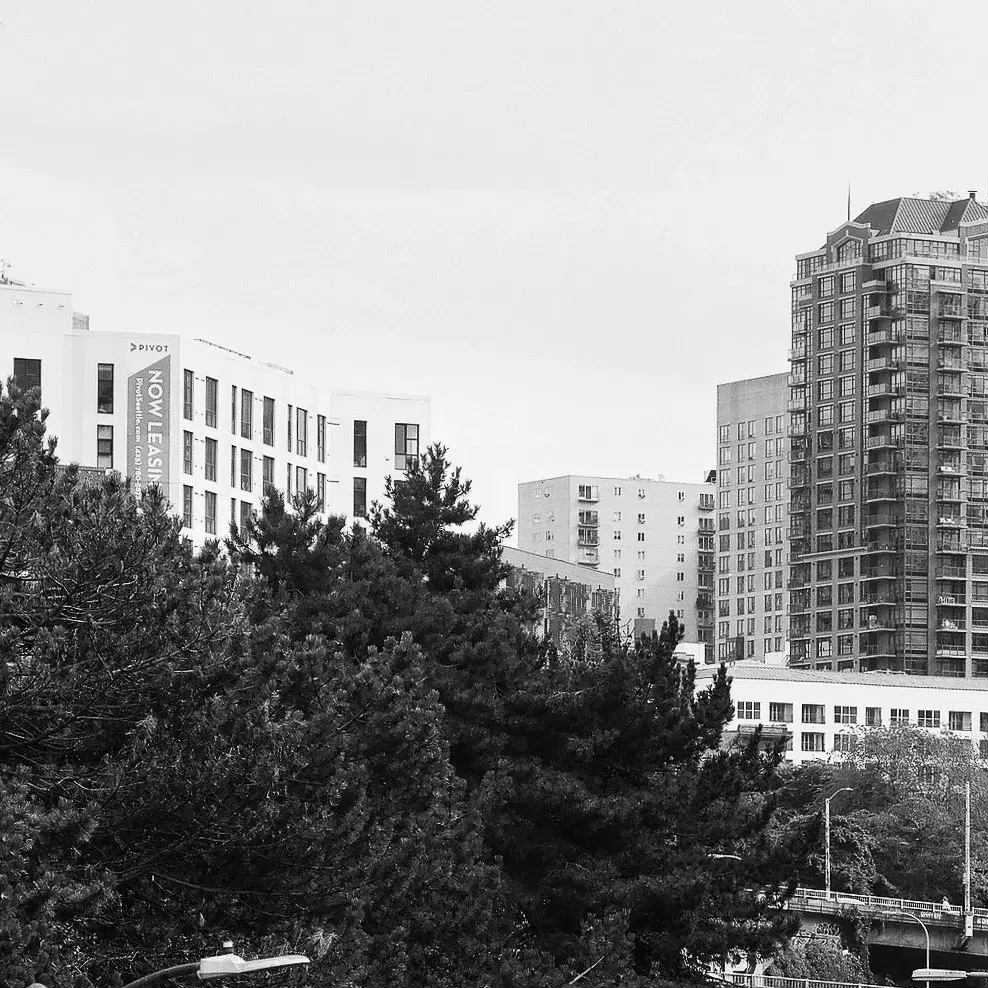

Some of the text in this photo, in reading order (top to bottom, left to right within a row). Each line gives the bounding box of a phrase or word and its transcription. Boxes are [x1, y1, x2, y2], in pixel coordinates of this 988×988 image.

[139, 344, 169, 352] PIVOT
[147, 370, 164, 490] NOW LEASIN
